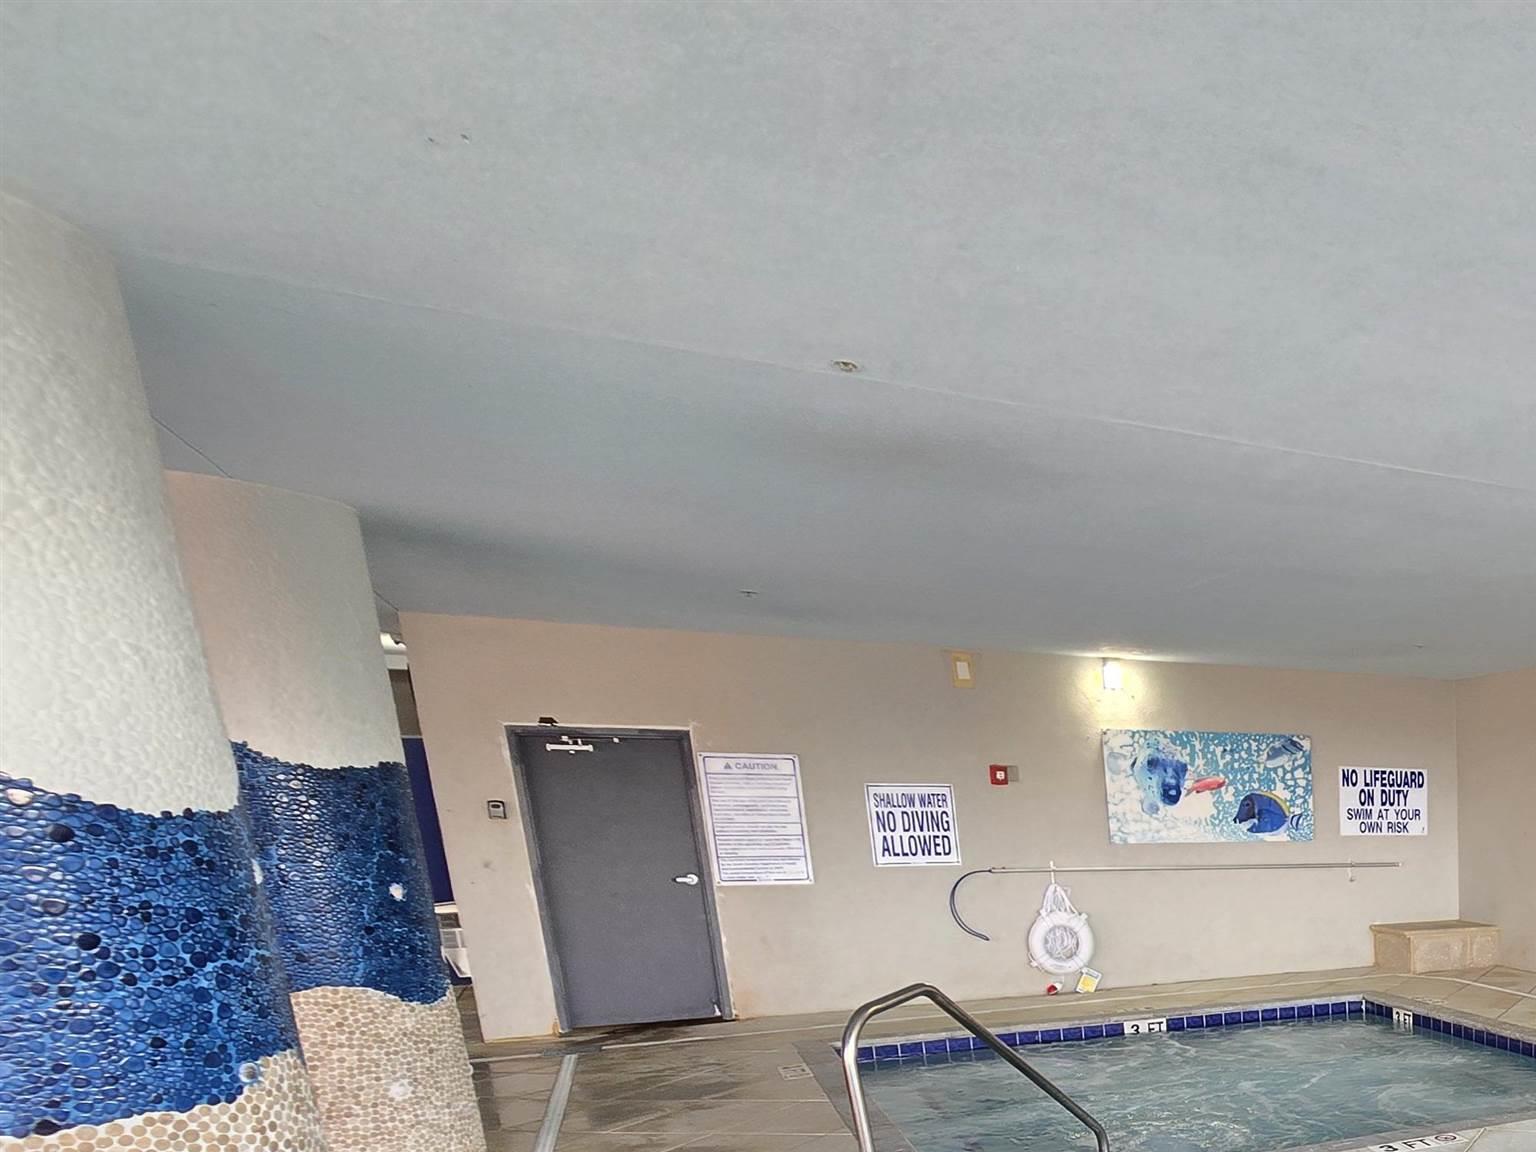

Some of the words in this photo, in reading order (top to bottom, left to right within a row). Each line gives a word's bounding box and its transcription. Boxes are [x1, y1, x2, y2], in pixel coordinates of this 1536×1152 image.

[735, 762, 779, 770] CAUTION
[1342, 768, 1358, 787] NO
[1364, 769, 1425, 788] LIFEGUARD
[873, 792, 916, 808] SHALLOW
[917, 793, 948, 808] WATER
[1359, 788, 1374, 806] ON
[1380, 788, 1409, 807] DUTY
[875, 810, 897, 832] NO
[901, 810, 950, 832] DIVING
[1346, 808, 1372, 820] SWIM
[1377, 808, 1390, 820] AT
[1394, 808, 1421, 820] YOUR
[1359, 821, 1382, 834] OWN
[1387, 821, 1409, 834] RISK
[882, 835, 952, 857] ALLOWED
[1131, 1024, 1140, 1034] 3
[1148, 1021, 1164, 1032] FT
[1379, 1144, 1399, 1152] 3
[1402, 1138, 1432, 1149] FT
